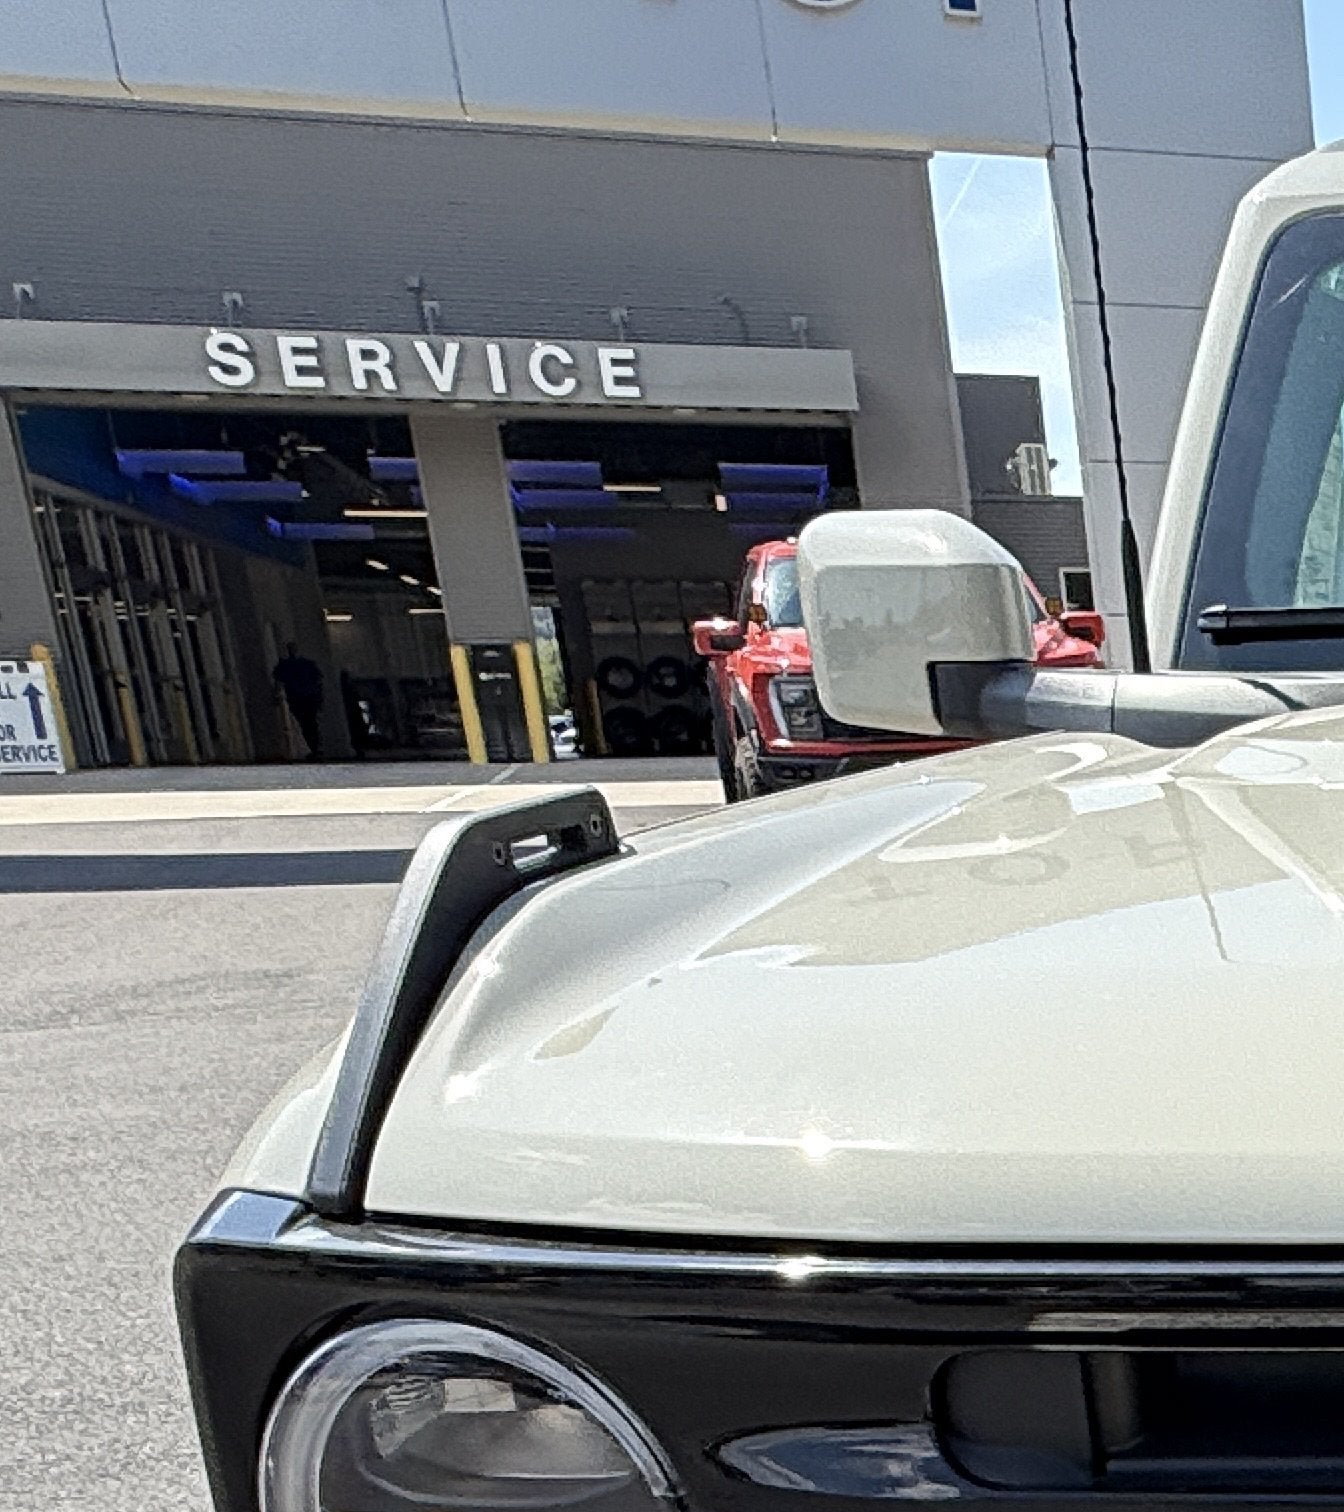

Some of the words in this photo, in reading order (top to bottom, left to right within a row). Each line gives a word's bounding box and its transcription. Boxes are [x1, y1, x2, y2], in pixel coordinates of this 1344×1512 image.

[204, 330, 642, 398] SERVICE
[0, 724, 17, 741] OR
[0, 744, 59, 763] ERVICE
